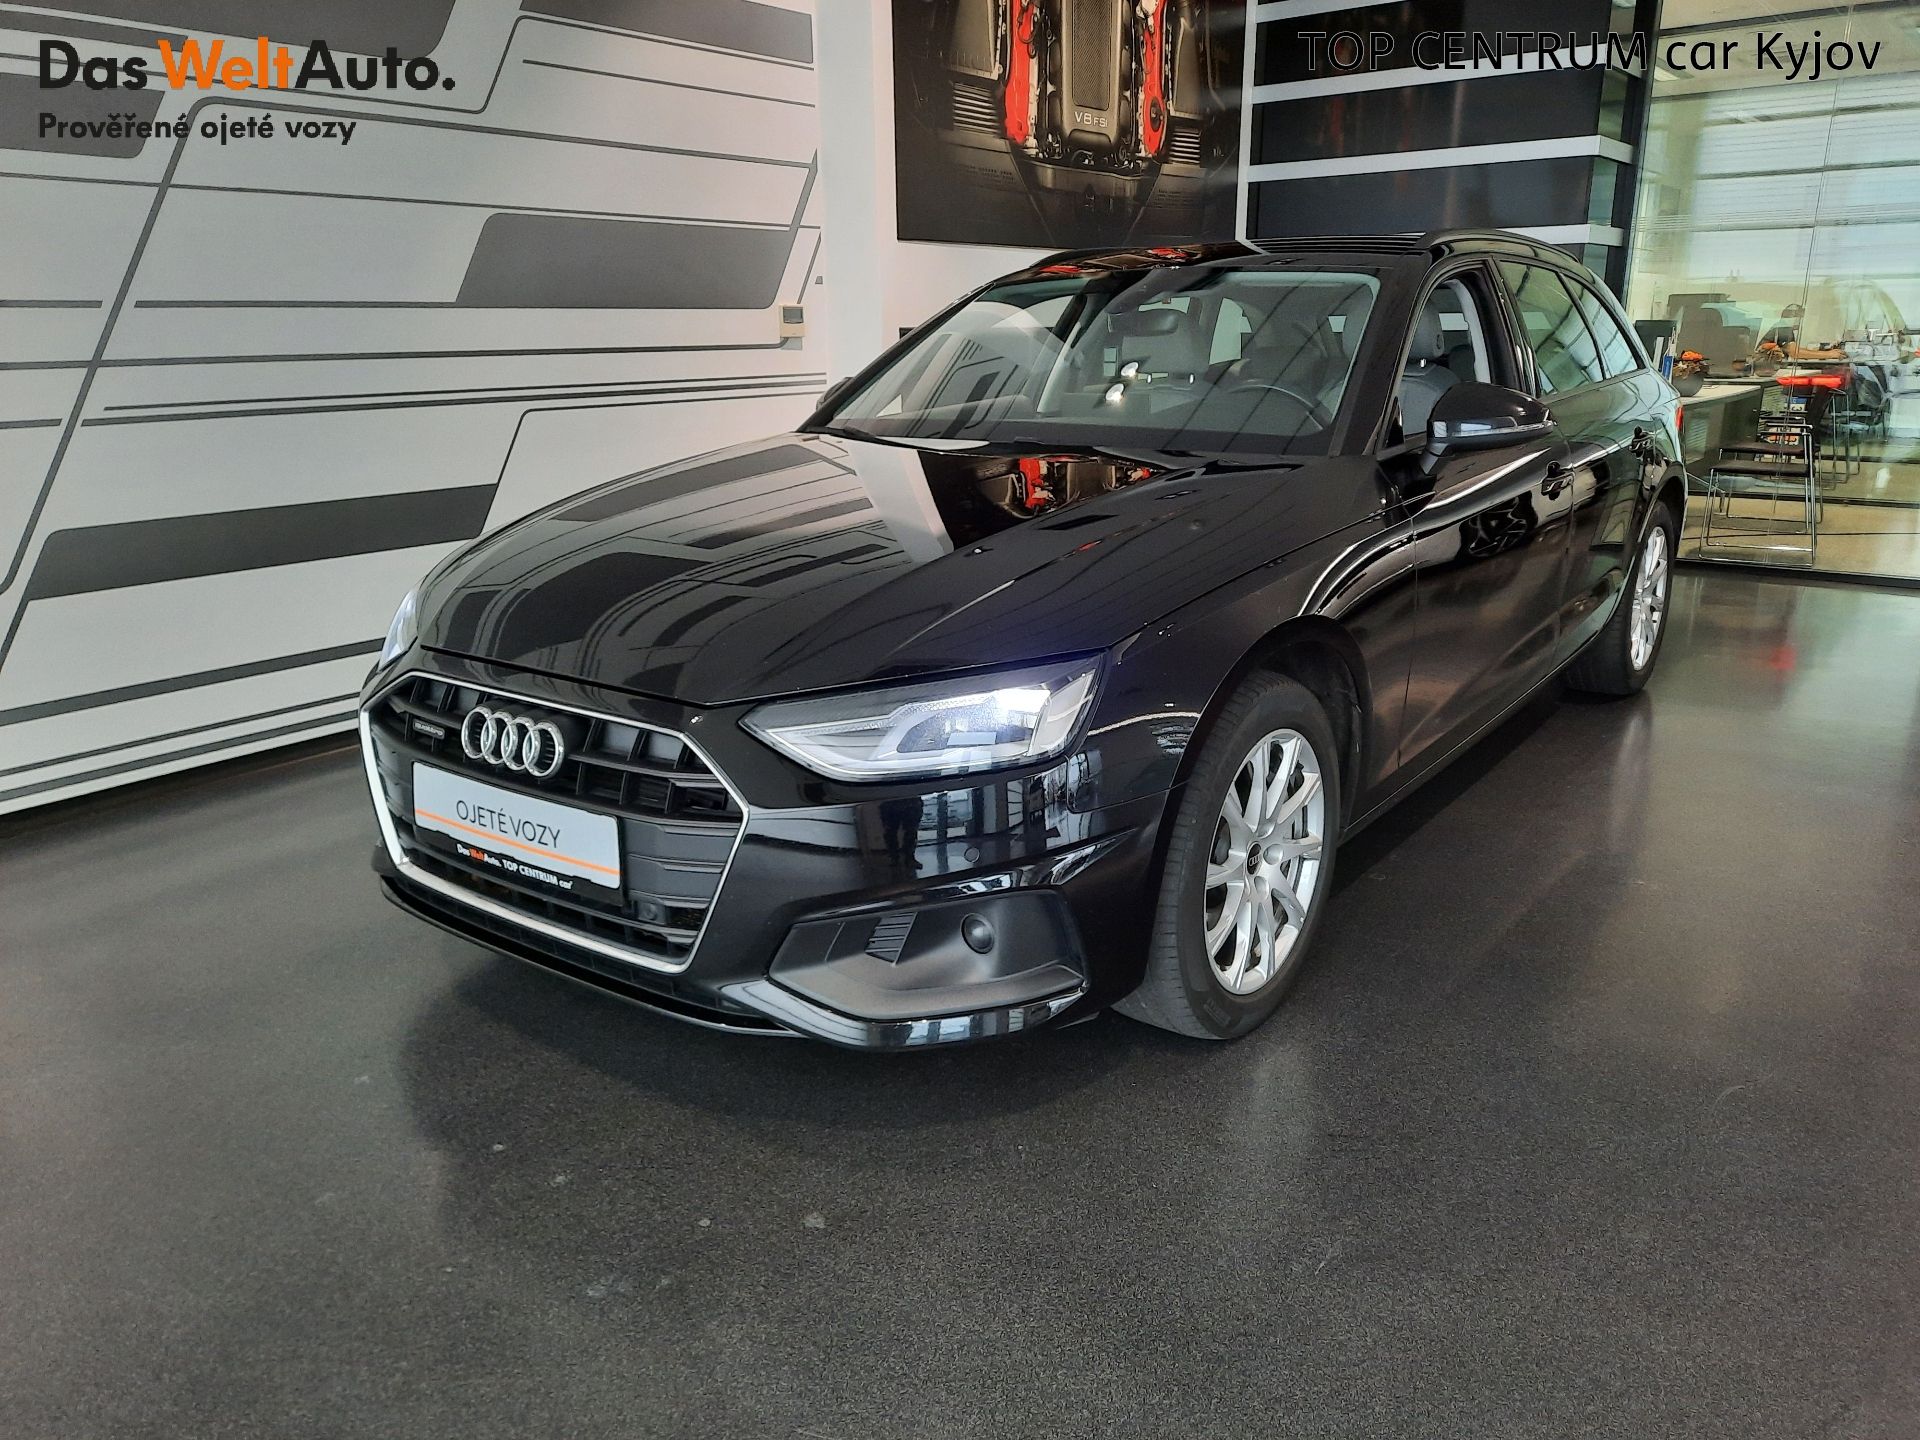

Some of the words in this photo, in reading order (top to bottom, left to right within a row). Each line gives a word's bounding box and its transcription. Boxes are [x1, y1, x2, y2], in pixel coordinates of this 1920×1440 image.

[456, 800, 508, 834] OJETÉ
[509, 815, 560, 848] VOZY
[502, 859, 518, 872] TOP
[518, 864, 558, 886] CENTRUM
